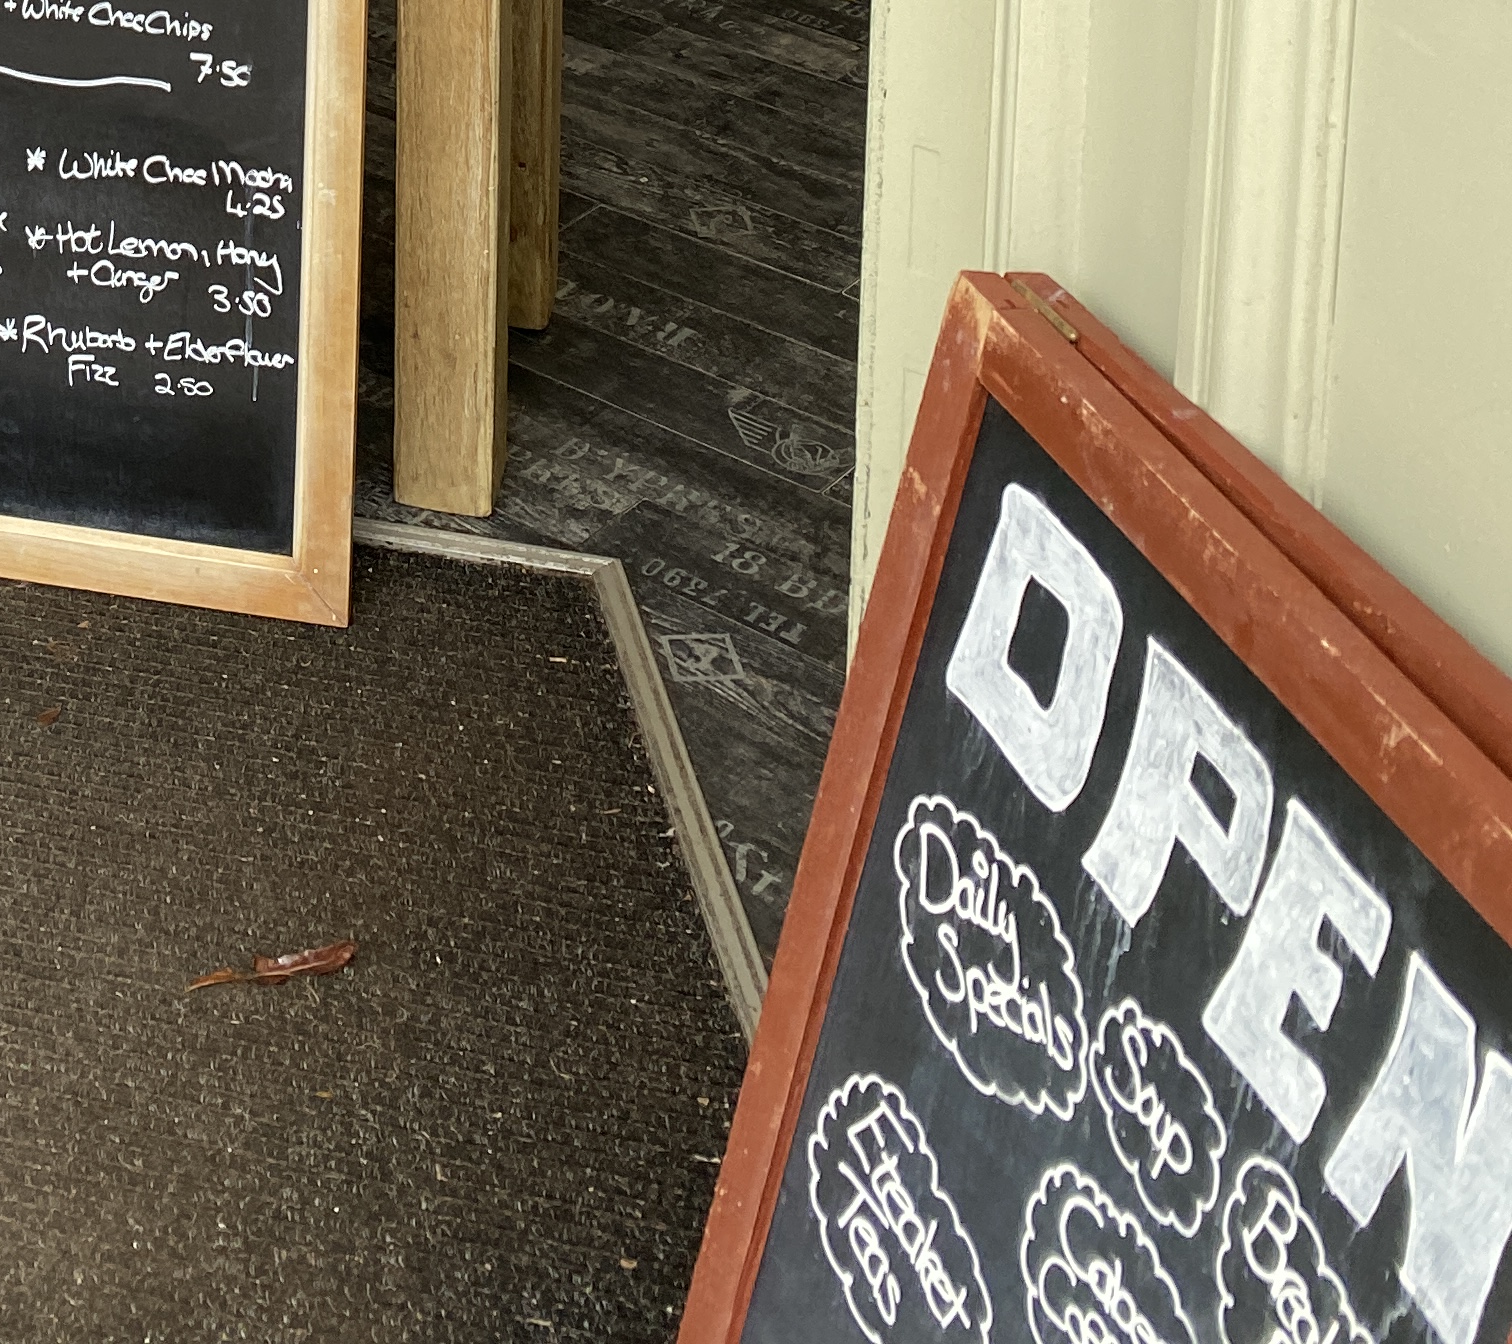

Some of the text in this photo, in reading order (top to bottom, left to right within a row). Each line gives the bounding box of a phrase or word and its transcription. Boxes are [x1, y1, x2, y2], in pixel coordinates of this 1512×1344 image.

[144, 10, 213, 41] Chips
[189, 52, 253, 87] 7.50
[58, 148, 293, 193] White Choc Mocha
[225, 190, 286, 219] 4.25
[56, 220, 104, 254] Hot
[90, 260, 180, 303] Ginger
[207, 285, 271, 317] 3.50
[22, 314, 136, 353] Rhubarb
[67, 354, 214, 396] Fizz 2.50
[919, 823, 1021, 990] Daily
[946, 483, 1512, 1344] OPEN
[935, 923, 1074, 1072] Specials
[1105, 1026, 1192, 1180] Soup
[838, 1162, 901, 1326] Teas
